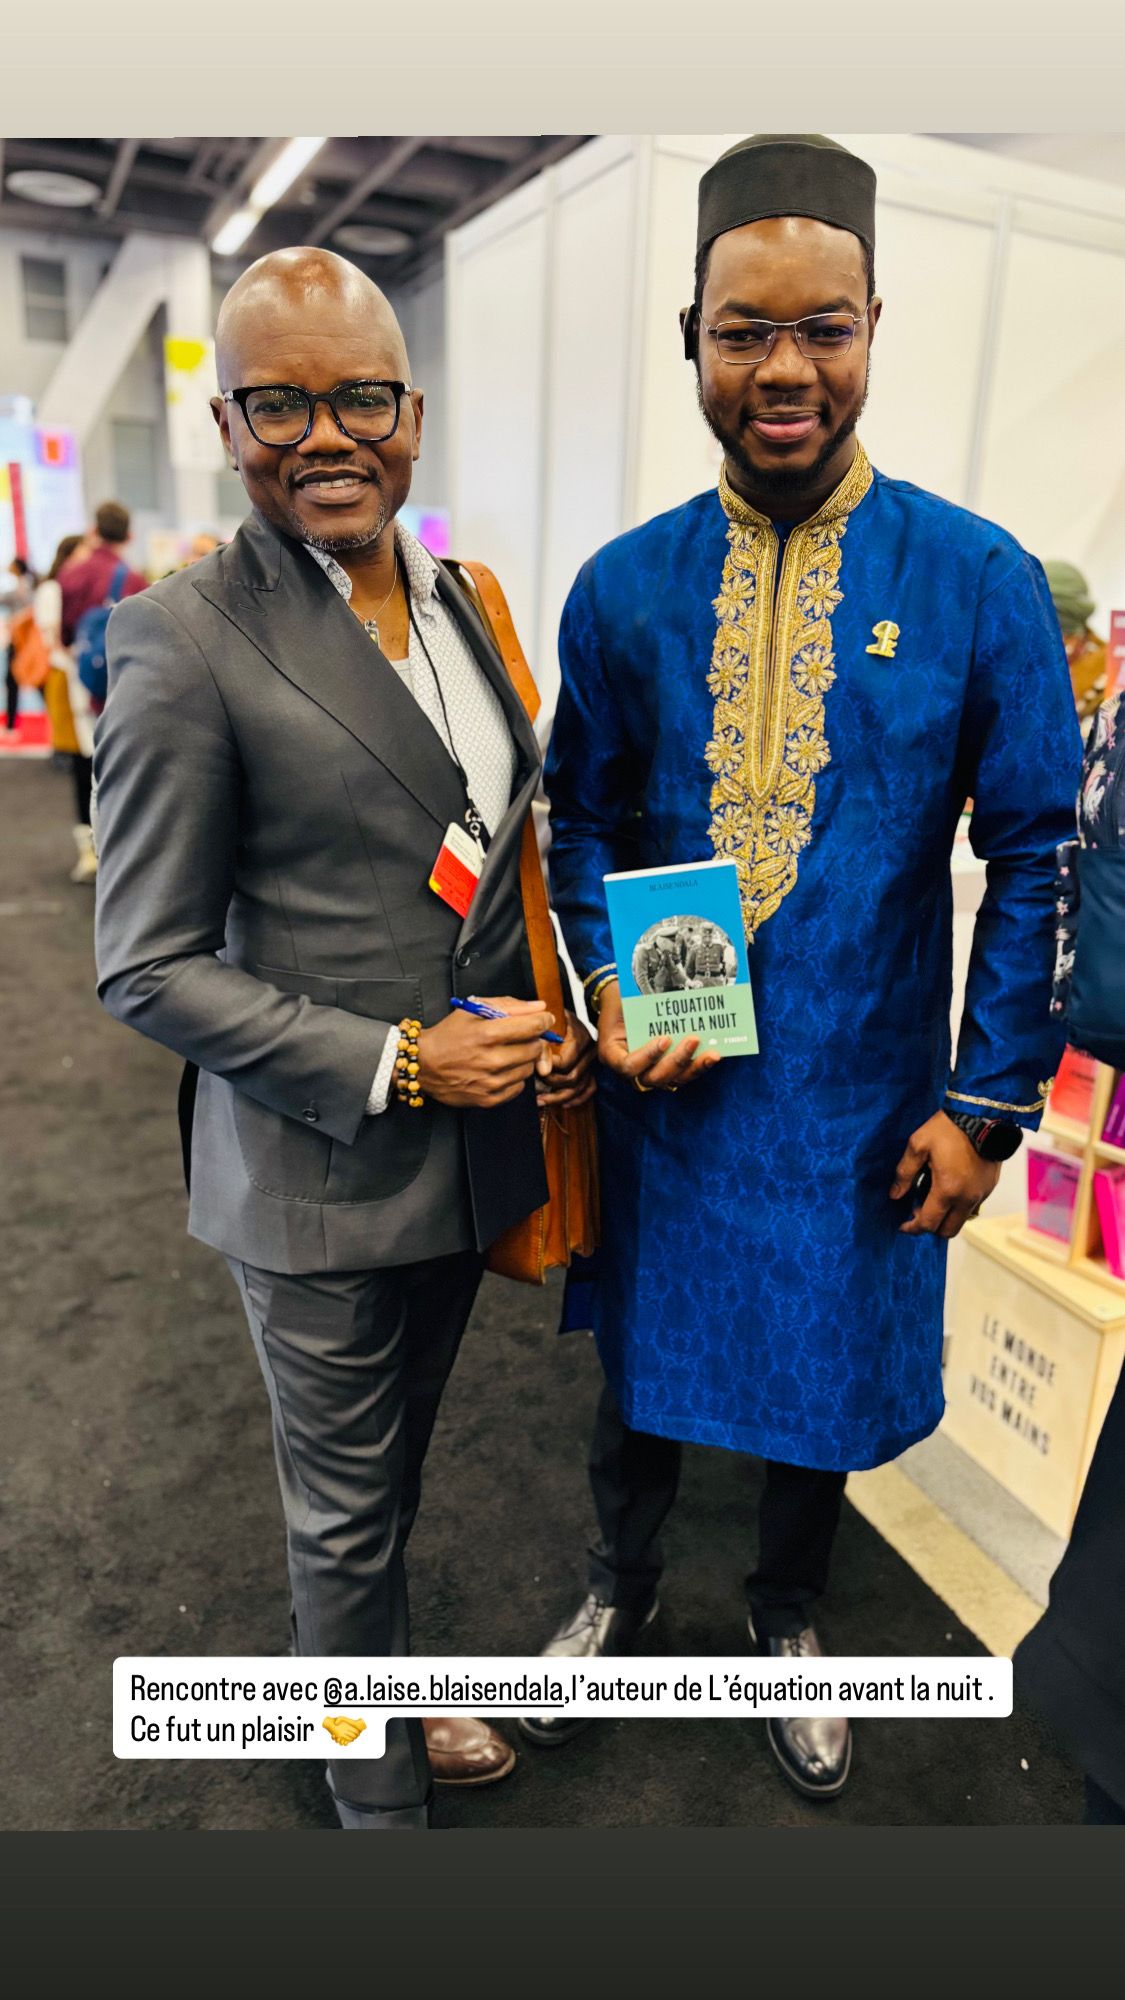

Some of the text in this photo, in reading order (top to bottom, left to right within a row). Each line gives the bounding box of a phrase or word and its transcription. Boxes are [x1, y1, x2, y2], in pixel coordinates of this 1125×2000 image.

[649, 1013, 737, 1037] AVANT LA NUIT
[656, 994, 725, 1017] L'ÉQUATION
[982, 1312, 1055, 1388] LE MONDE
[990, 1355, 1036, 1408] ENTRE
[970, 1374, 1050, 1456] VOS MAINS
